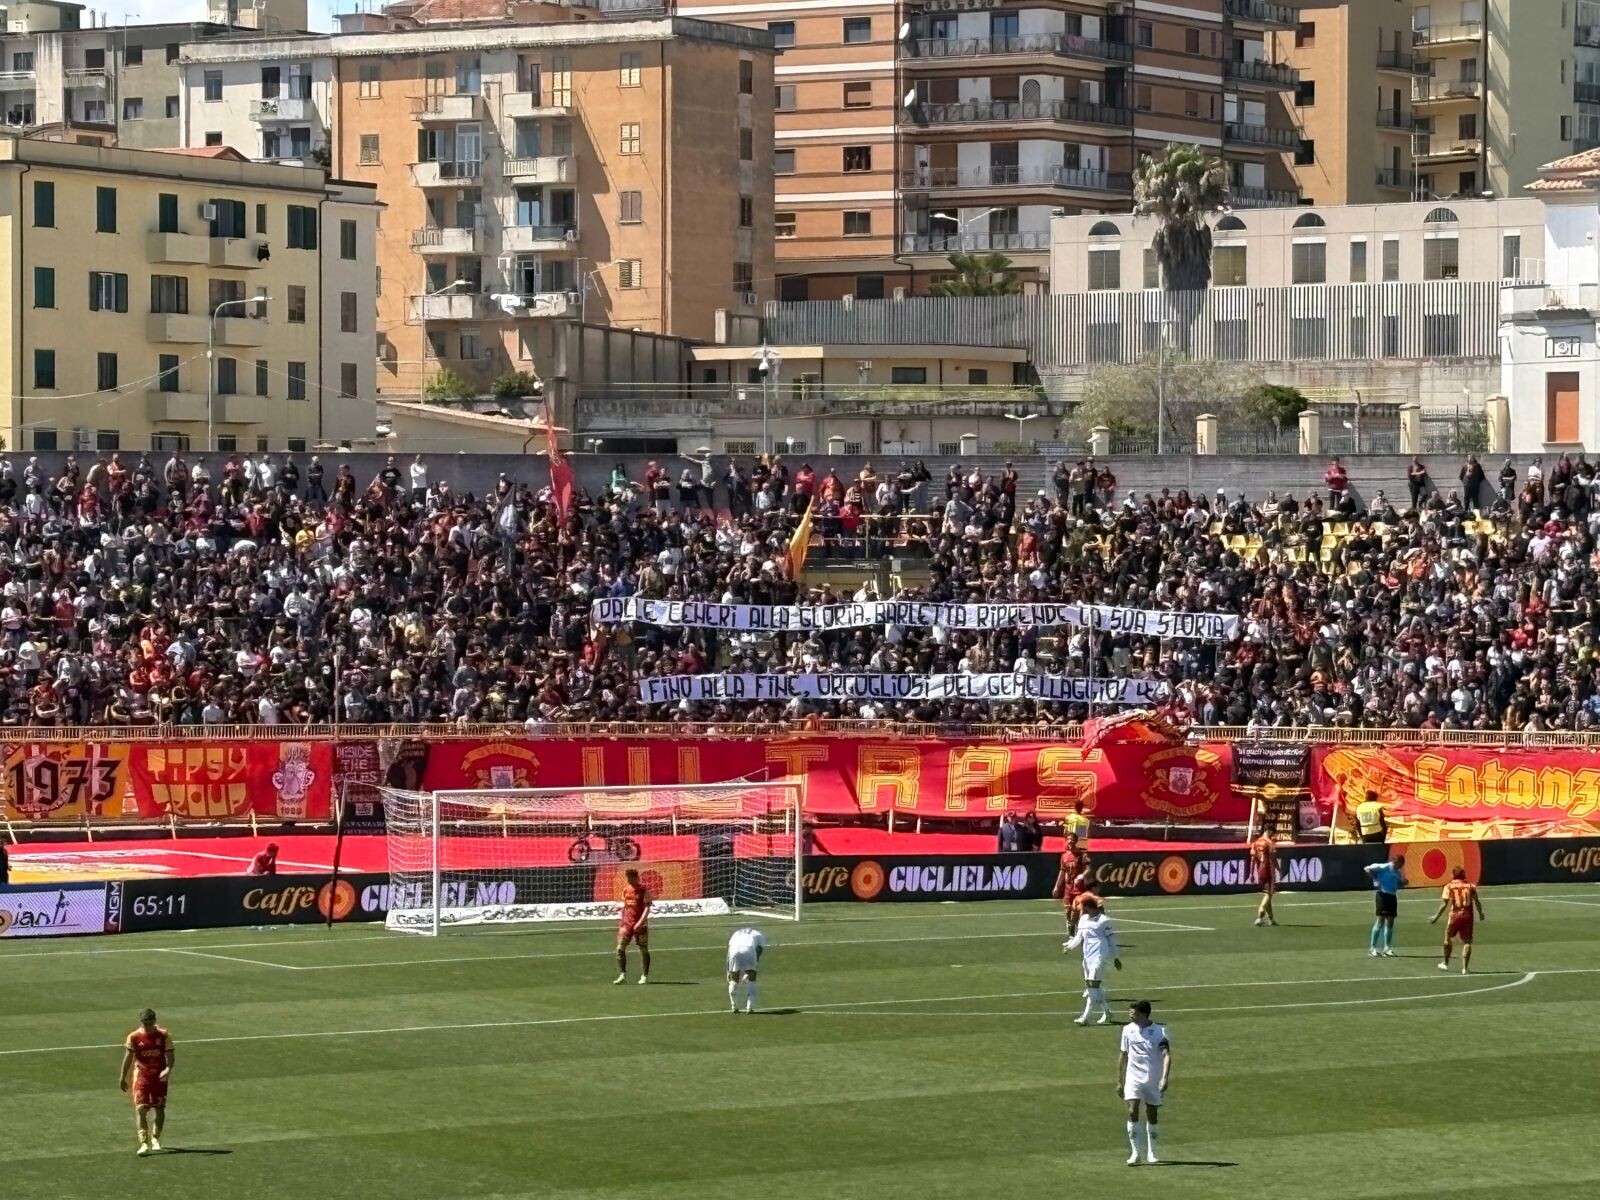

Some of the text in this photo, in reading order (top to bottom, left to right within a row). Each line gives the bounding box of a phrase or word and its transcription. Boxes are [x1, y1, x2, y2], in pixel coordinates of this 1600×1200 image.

[701, 676, 745, 698] ALLA
[9, 759, 122, 806] 1973
[889, 864, 1028, 892] GUGLIELMO
[1095, 861, 1155, 888] Caffè
[133, 894, 186, 916] 65:11
[242, 886, 317, 916] Caffè
